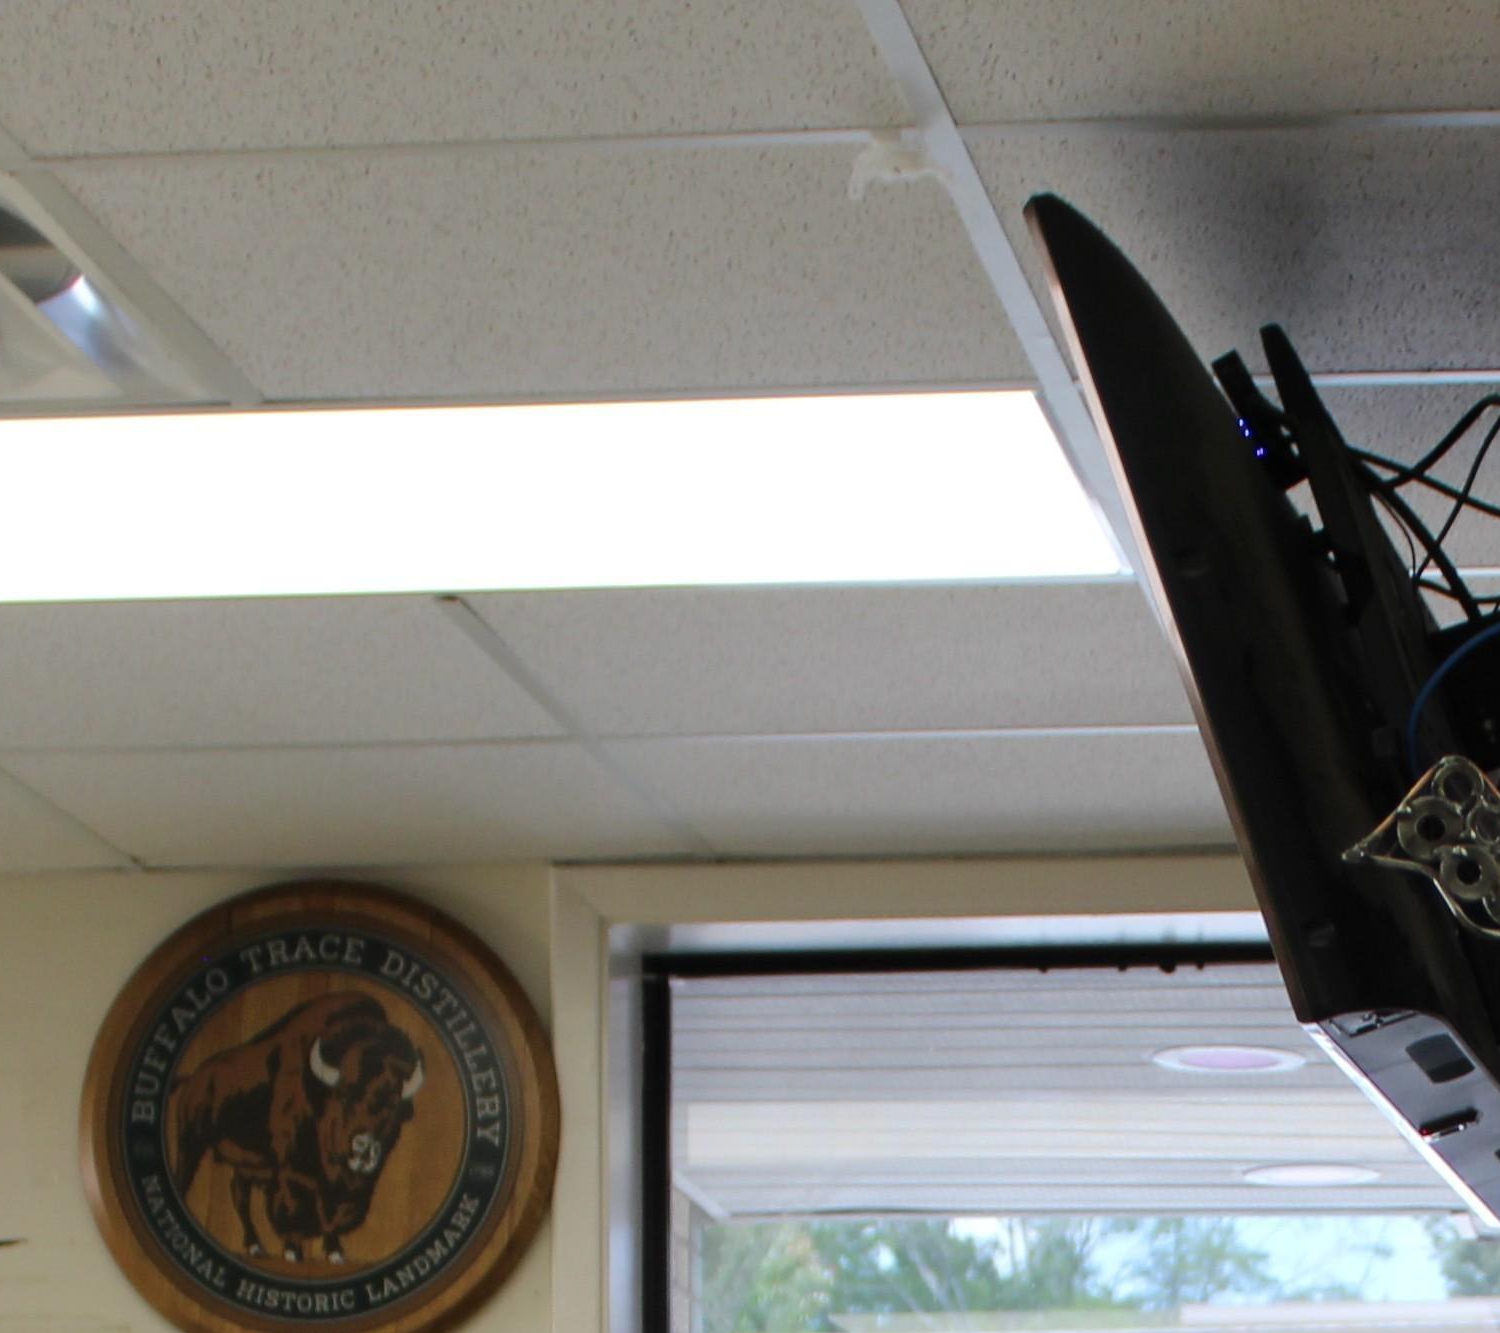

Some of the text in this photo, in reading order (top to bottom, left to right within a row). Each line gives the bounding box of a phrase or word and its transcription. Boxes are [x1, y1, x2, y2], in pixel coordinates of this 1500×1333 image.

[130, 934, 502, 1149] BUFFALO TRACE DISTILLERY
[140, 1173, 481, 1314] NATIONAL HISTORIC LANDMARK
